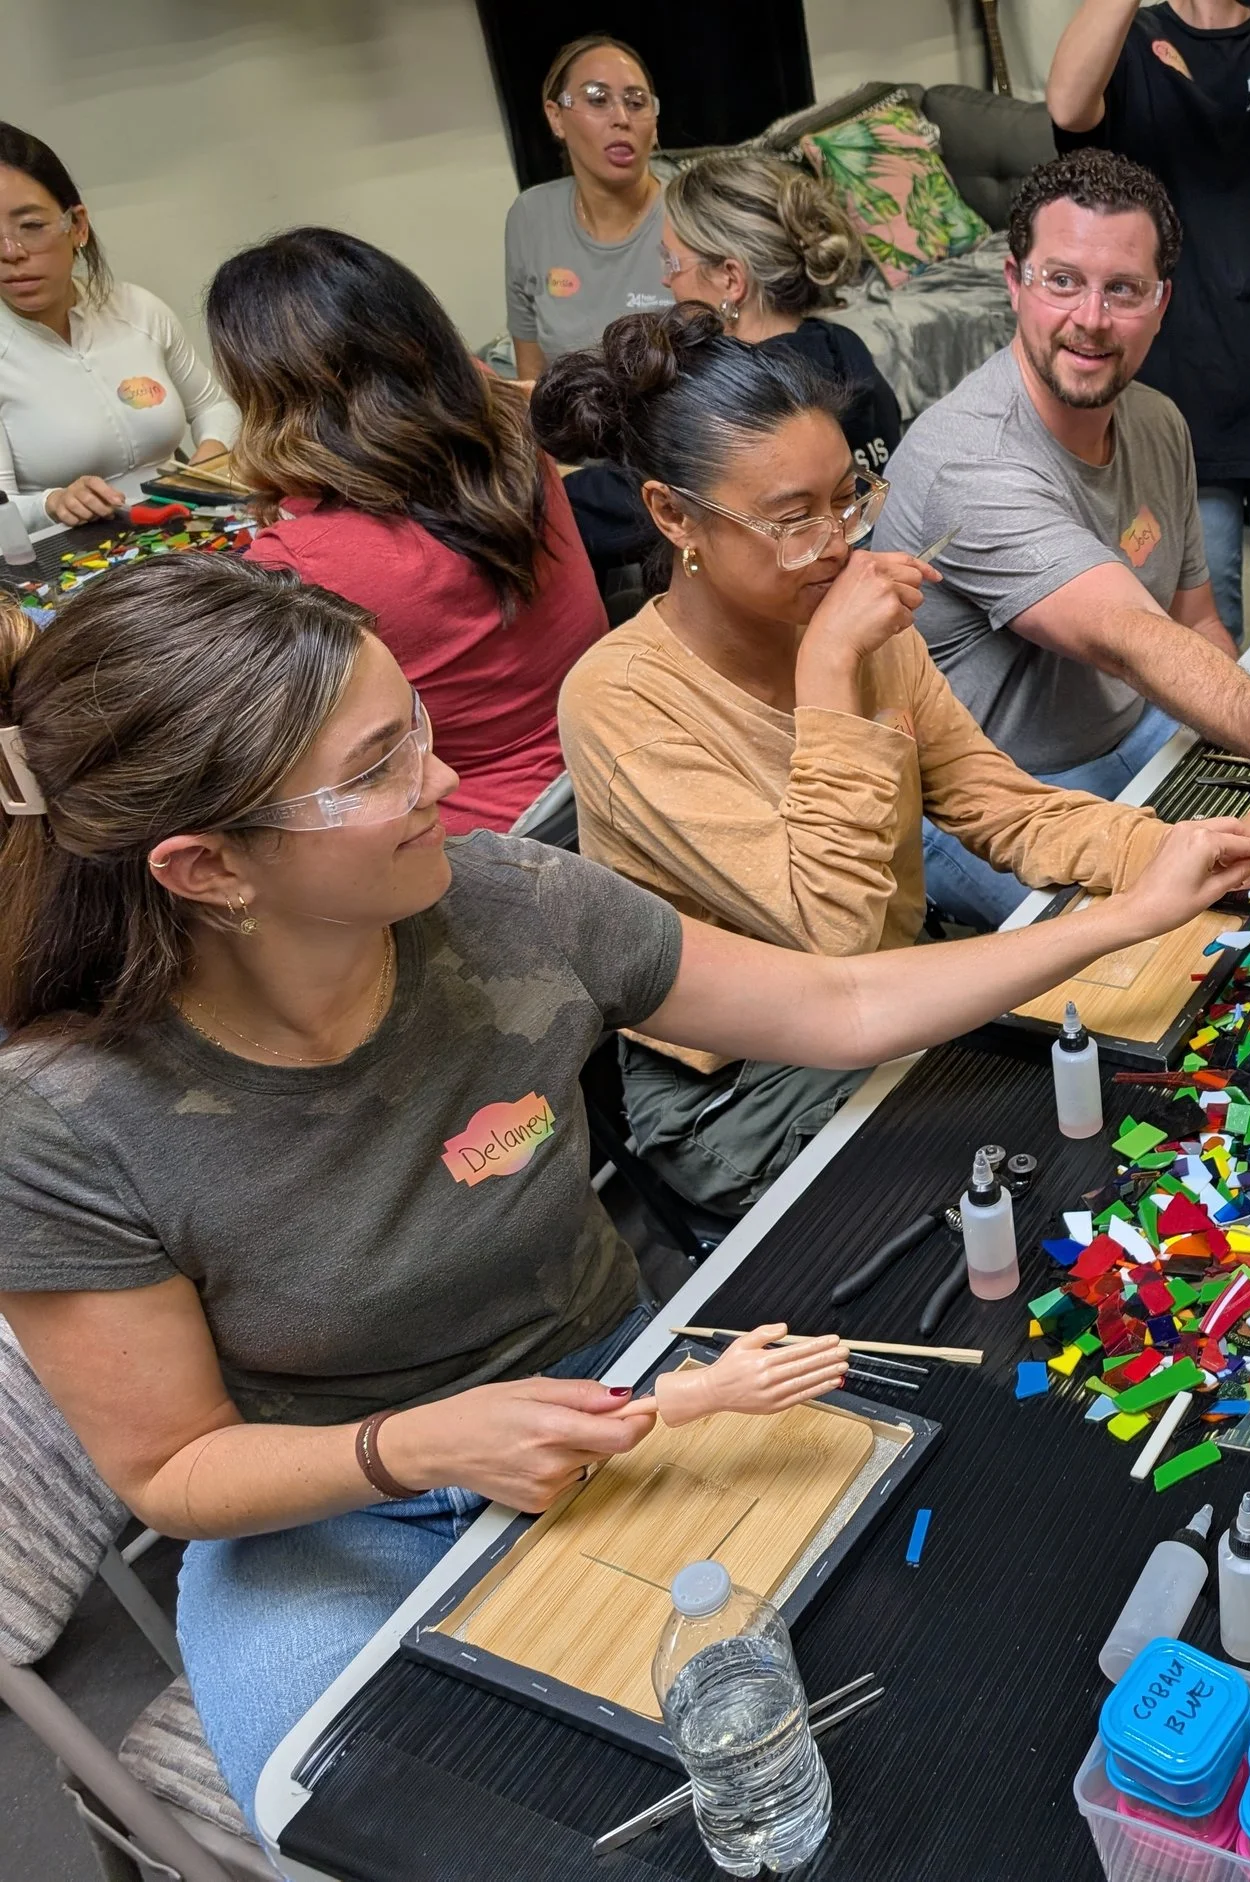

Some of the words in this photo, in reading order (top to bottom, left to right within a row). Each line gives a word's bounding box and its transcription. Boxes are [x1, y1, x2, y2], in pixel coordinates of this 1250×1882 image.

[866, 437, 889, 467] IS
[1128, 522, 1156, 553] Joey
[458, 1104, 549, 1174] Delaney
[1164, 1676, 1215, 1736] BLUE
